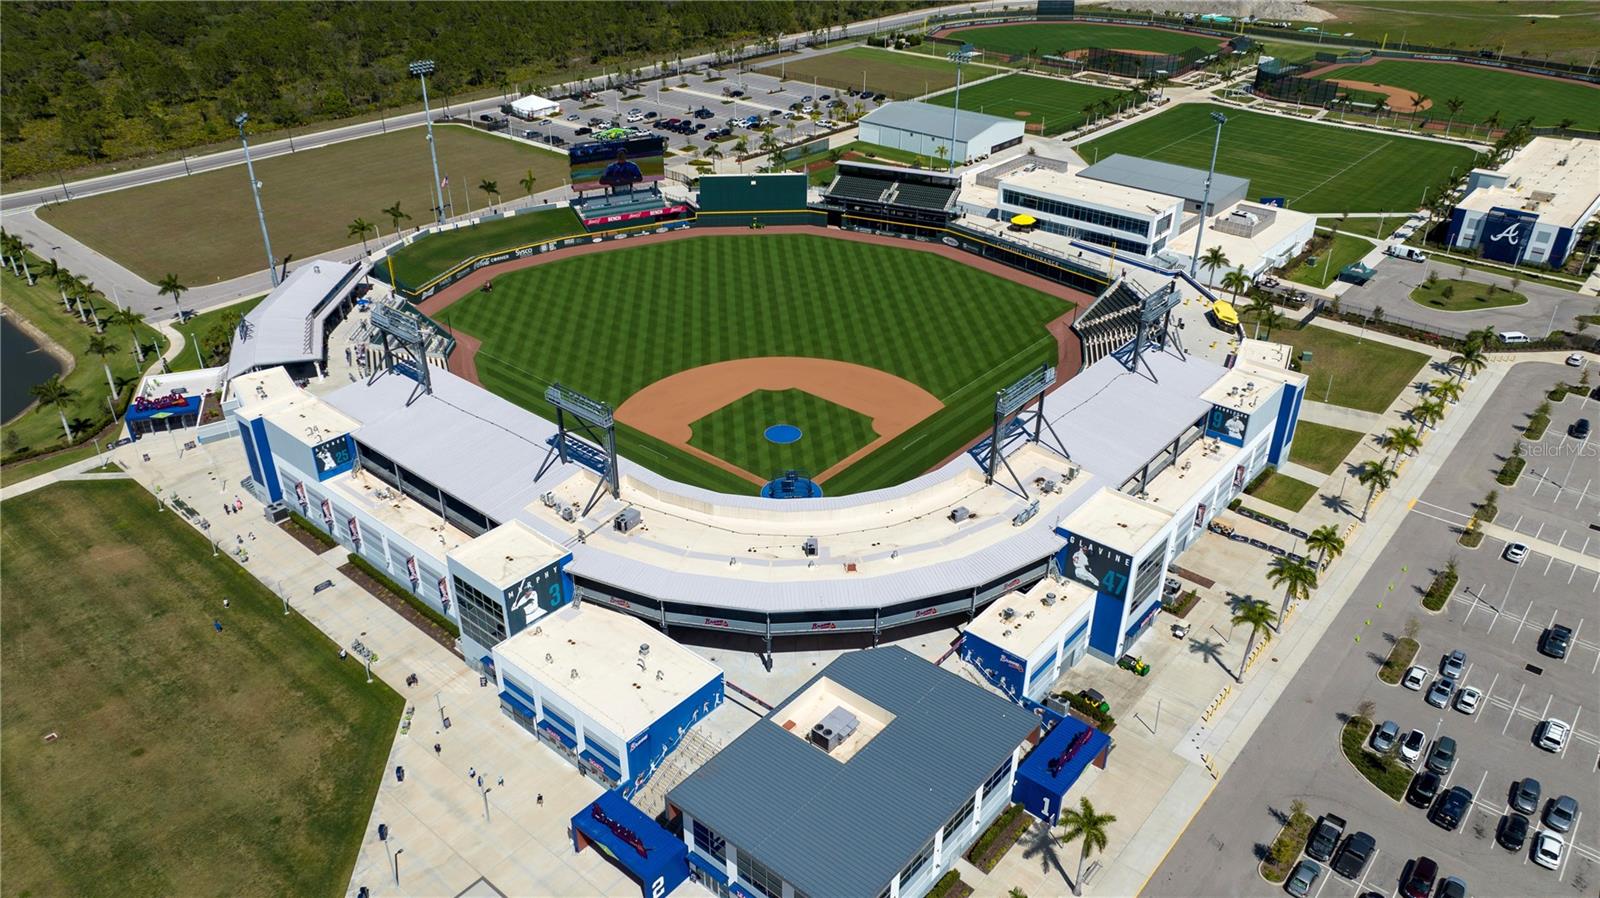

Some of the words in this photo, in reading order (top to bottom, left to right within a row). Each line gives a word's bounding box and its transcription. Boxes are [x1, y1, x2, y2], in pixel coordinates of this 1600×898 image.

[1213, 410, 1223, 428] 9
[336, 449, 349, 464] 25
[1069, 535, 1130, 566] GLAVINE
[1103, 569, 1128, 595] 47
[548, 583, 561, 607] 3
[1041, 797, 1051, 816] 1
[651, 876, 666, 898] 2
